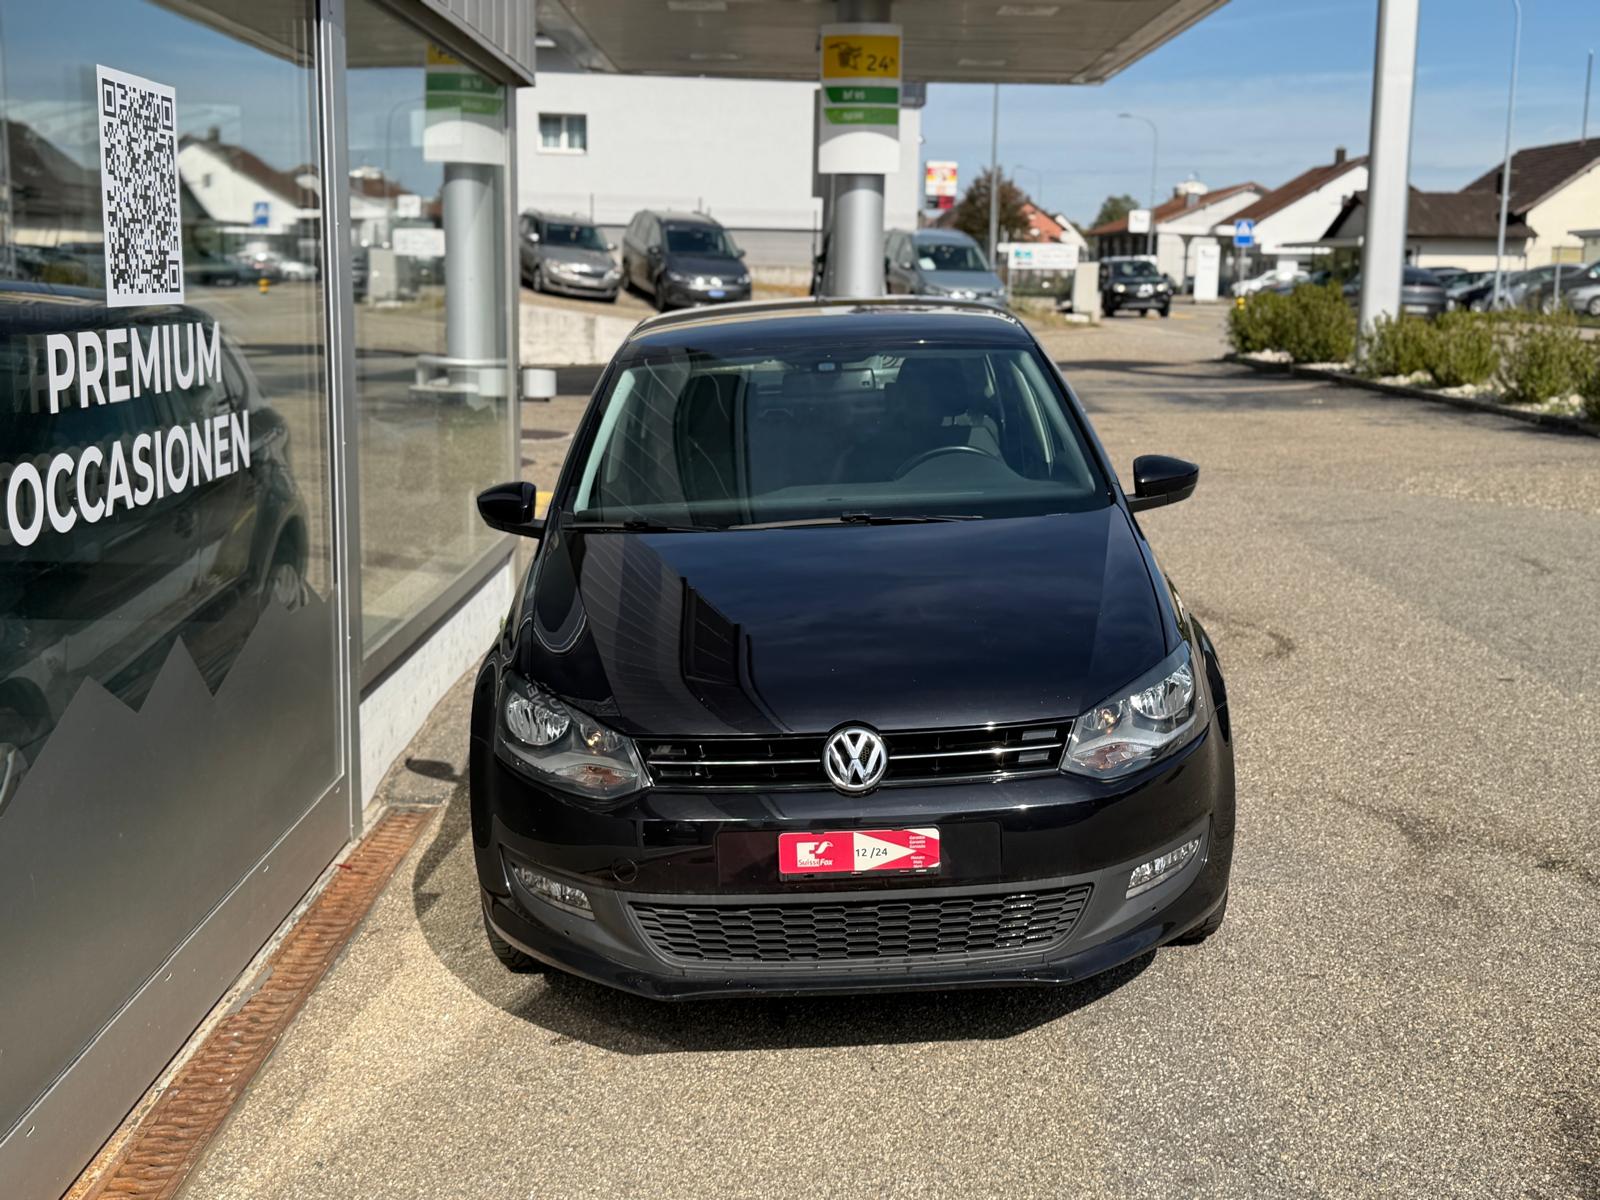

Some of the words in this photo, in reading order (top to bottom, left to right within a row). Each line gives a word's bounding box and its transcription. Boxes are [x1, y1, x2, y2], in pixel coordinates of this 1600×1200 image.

[46, 321, 222, 414] PREMIUM
[7, 409, 251, 546] OCCASIONEN
[856, 848, 867, 857] 12
[870, 847, 888, 858] /24
